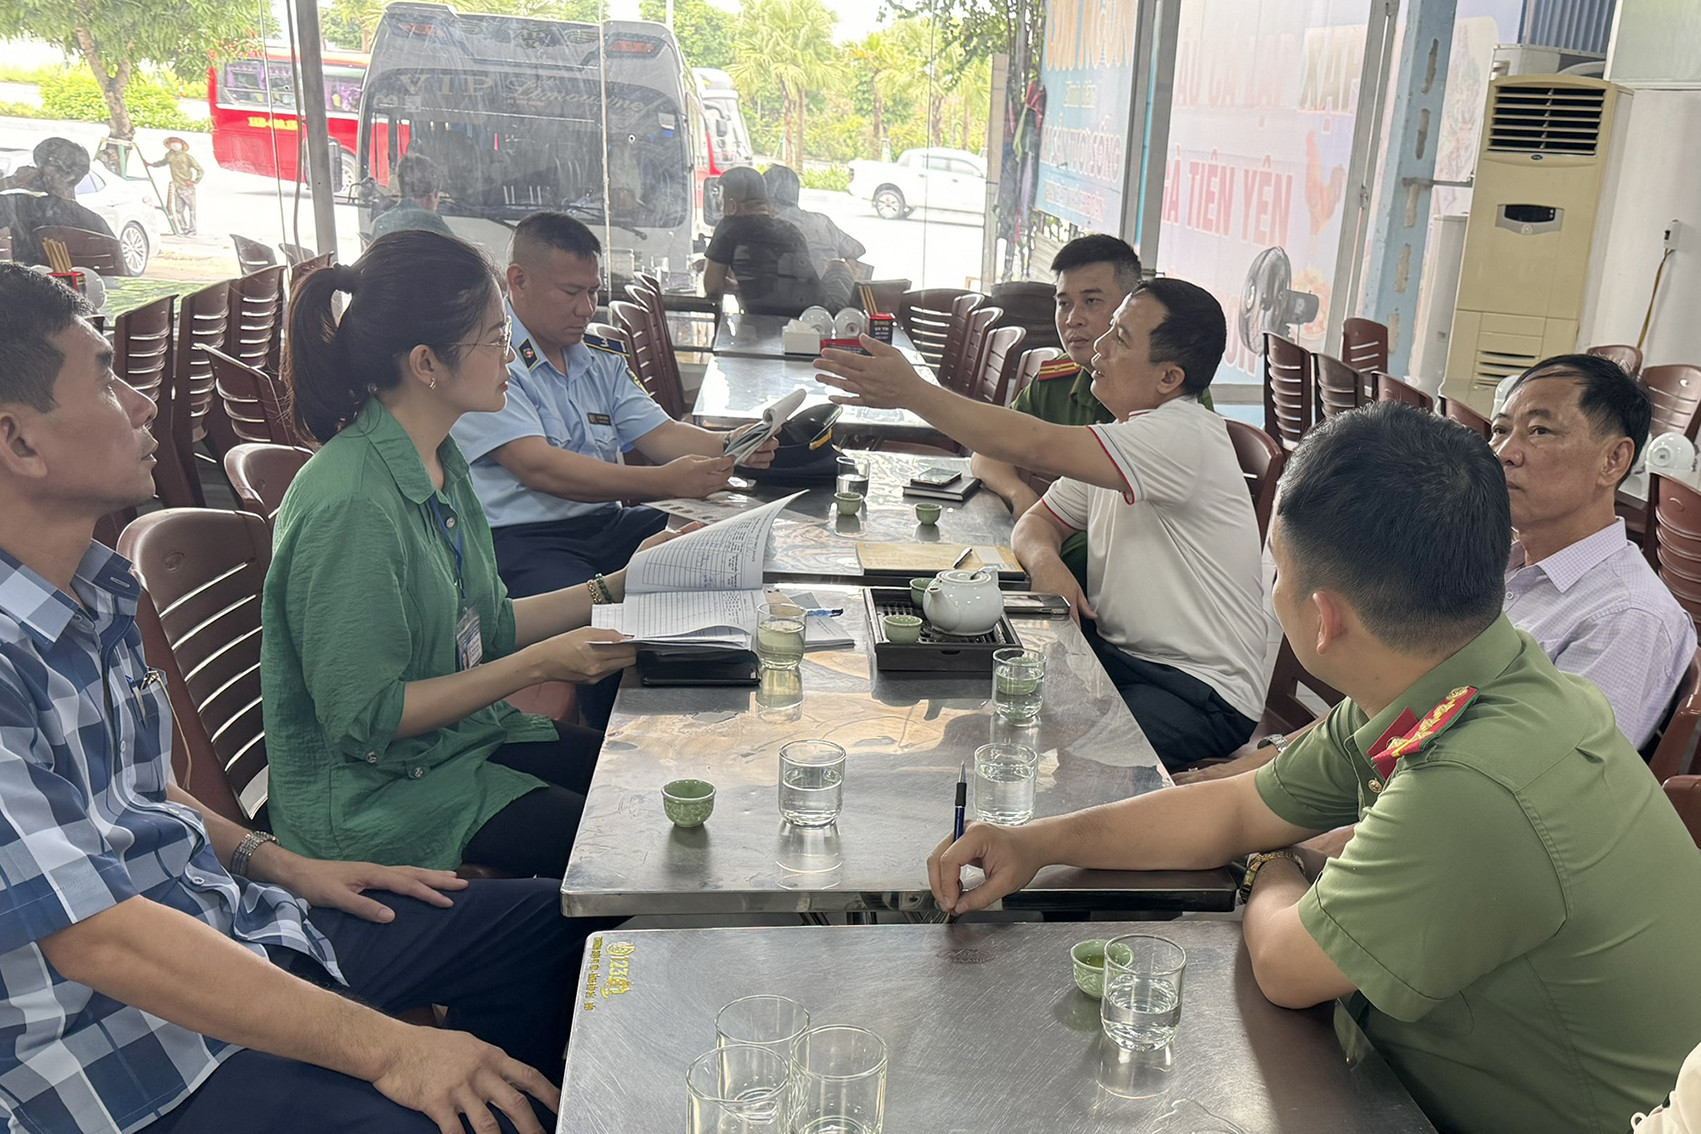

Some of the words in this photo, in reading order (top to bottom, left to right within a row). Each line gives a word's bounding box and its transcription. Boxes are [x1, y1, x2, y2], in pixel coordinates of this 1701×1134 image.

[397, 74, 494, 96] VIP
[1186, 149, 1236, 237] TIÊN
[1241, 155, 1293, 248] YÊN
